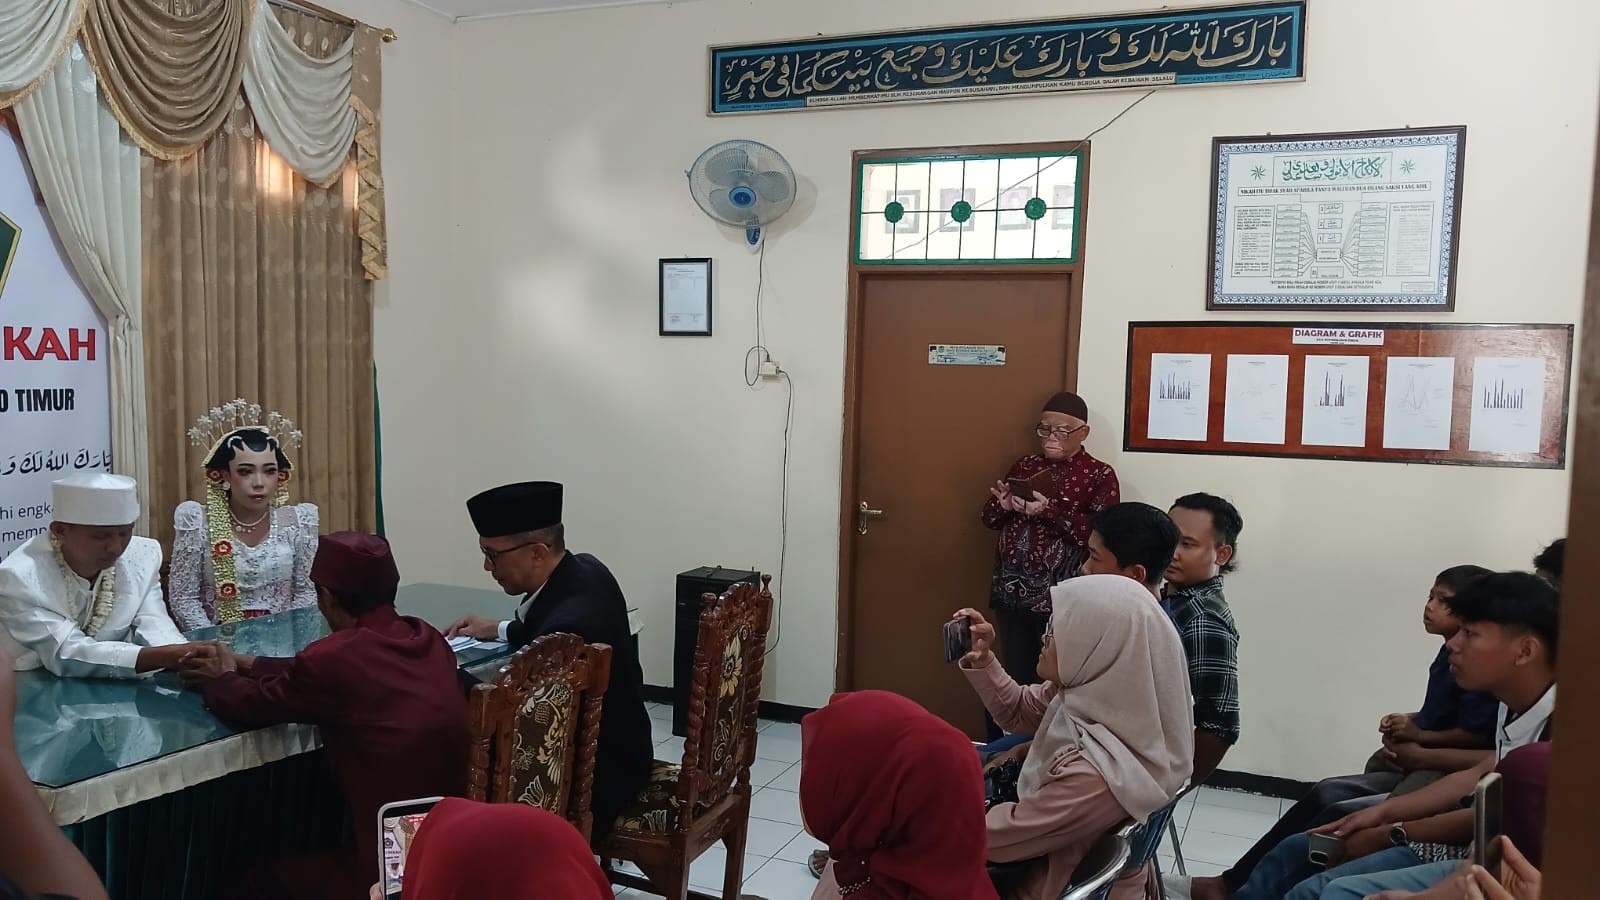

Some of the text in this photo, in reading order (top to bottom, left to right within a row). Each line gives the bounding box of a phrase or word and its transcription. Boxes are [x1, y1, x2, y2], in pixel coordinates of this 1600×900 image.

[1294, 329, 1382, 339] DIAGRAM & GRAFIK
[14, 388, 75, 412] TIMUR
[18, 501, 54, 519] engk
